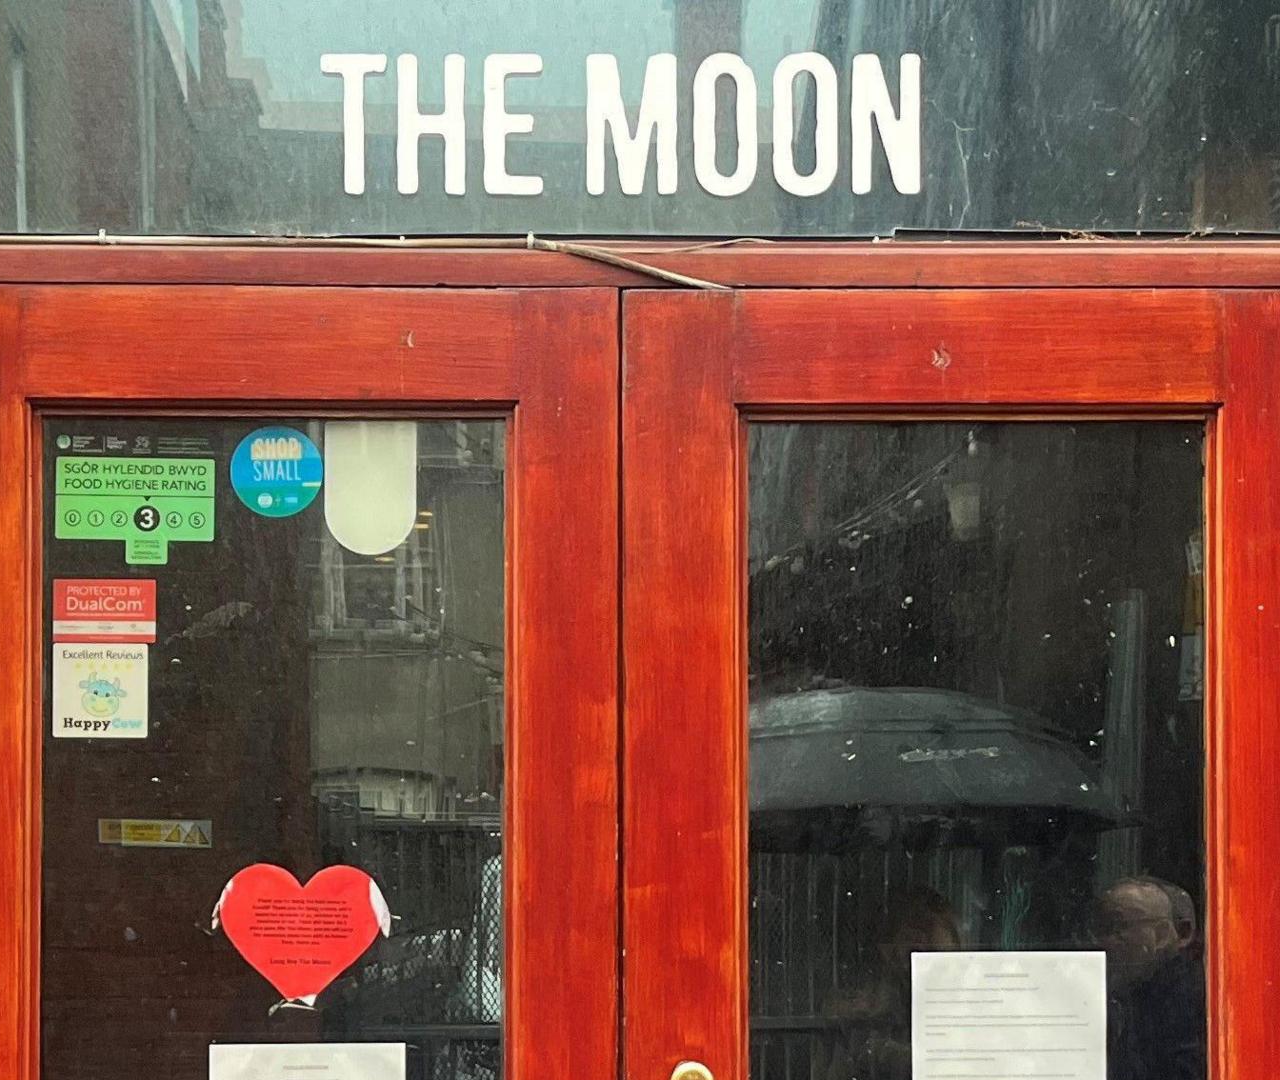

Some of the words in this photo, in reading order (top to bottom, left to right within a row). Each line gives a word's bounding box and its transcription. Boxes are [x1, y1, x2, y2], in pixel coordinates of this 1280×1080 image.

[320, 52, 544, 195] THE
[586, 51, 921, 197] MOON
[64, 461, 99, 474] SGÔR
[103, 464, 164, 475] HYLENDID
[168, 465, 207, 476] BWYD
[253, 460, 301, 481] SMALL
[64, 478, 102, 489] FOOD
[105, 479, 159, 490] HYGIENE
[161, 480, 206, 491] RATING
[140, 508, 154, 529] 3
[66, 586, 127, 597] PROTECTED
[129, 586, 142, 597] BY
[66, 596, 143, 612] DualCom
[62, 650, 103, 660] Excellent
[106, 650, 144, 660] Reviews
